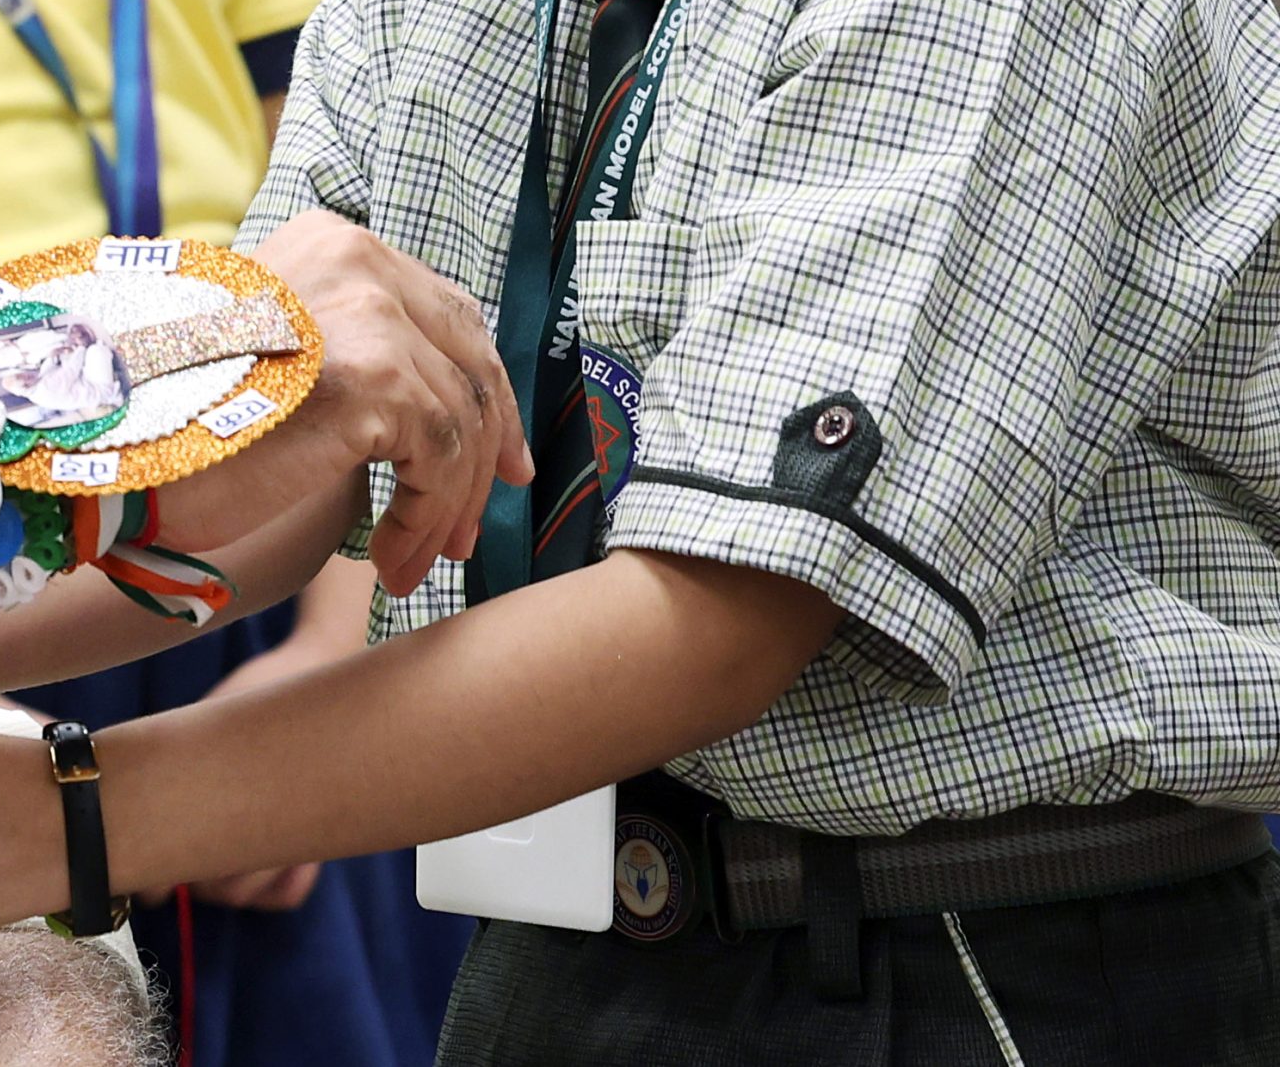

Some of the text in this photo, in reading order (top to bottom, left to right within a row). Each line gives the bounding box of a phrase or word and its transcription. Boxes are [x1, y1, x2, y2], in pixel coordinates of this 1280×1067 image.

[604, 83, 654, 181] MODEL
[105, 244, 173, 267] नाम
[581, 355, 613, 387] DEL
[215, 400, 270, 433] एक
